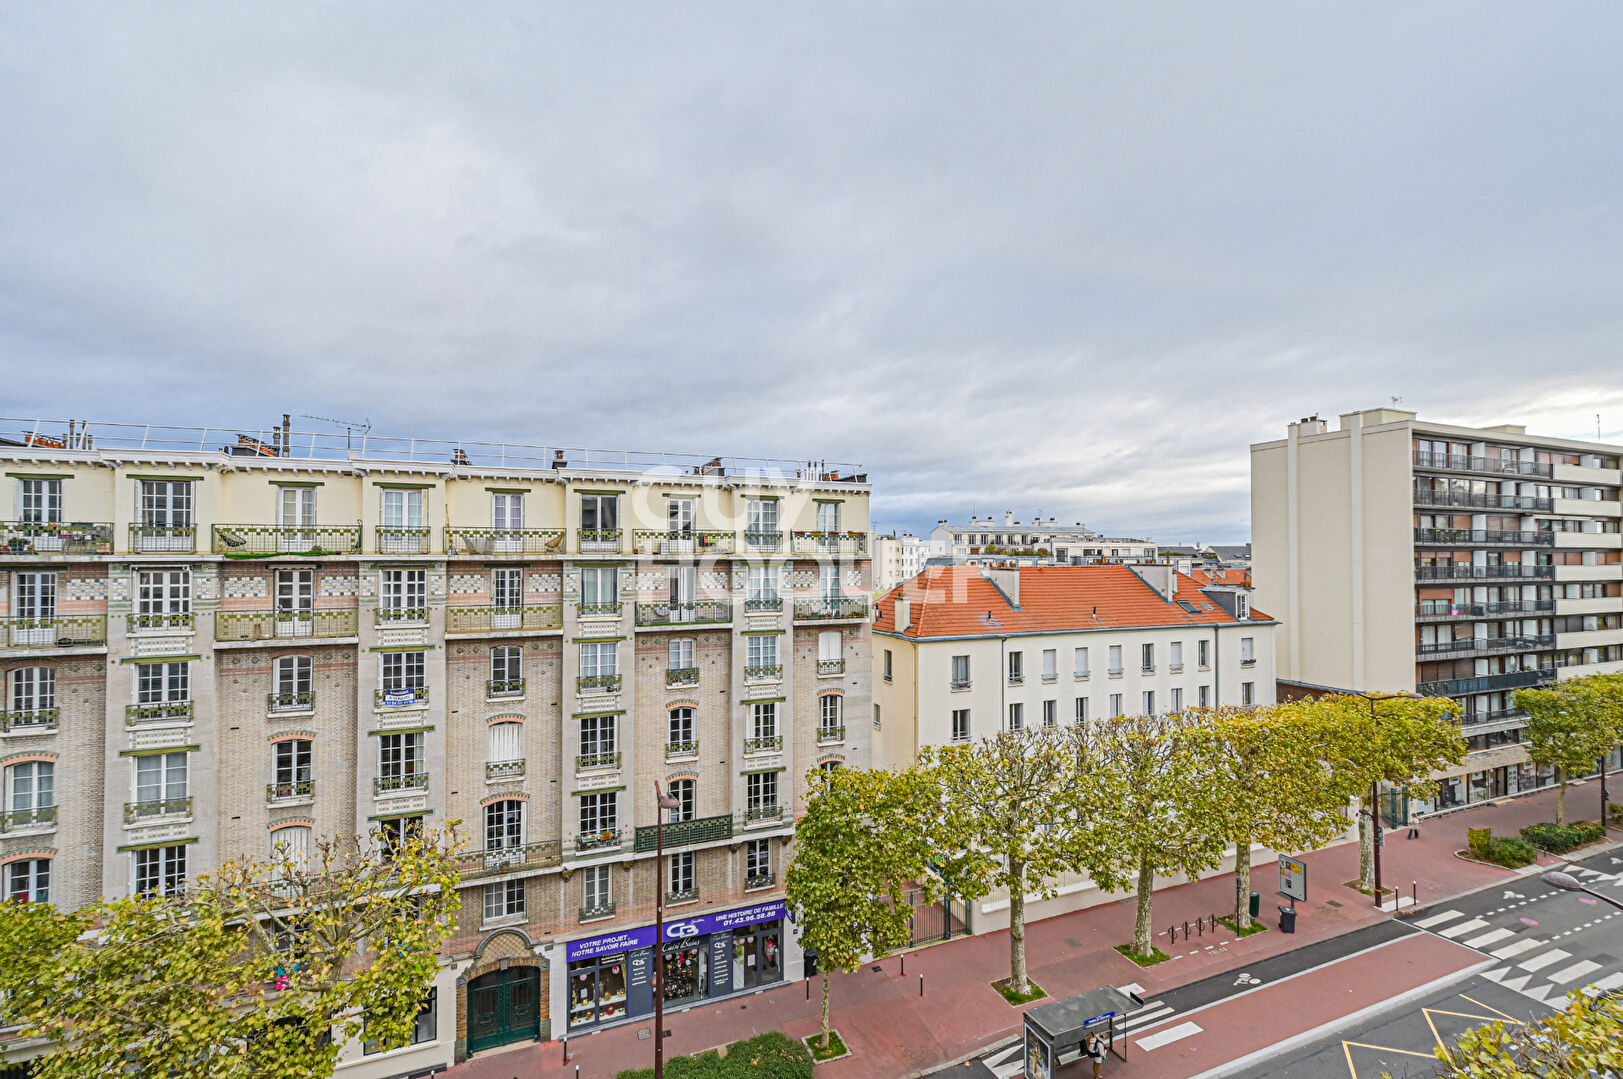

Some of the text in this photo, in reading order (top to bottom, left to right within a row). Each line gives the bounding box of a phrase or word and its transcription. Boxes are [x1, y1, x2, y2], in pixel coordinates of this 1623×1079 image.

[715, 913, 728, 921] UNE
[728, 909, 753, 919] HISTOIRE
[761, 902, 784, 912] FAMILLE
[571, 938, 639, 957] NOTRE SAVOIR FAIRE
[579, 939, 601, 949] VOTRE
